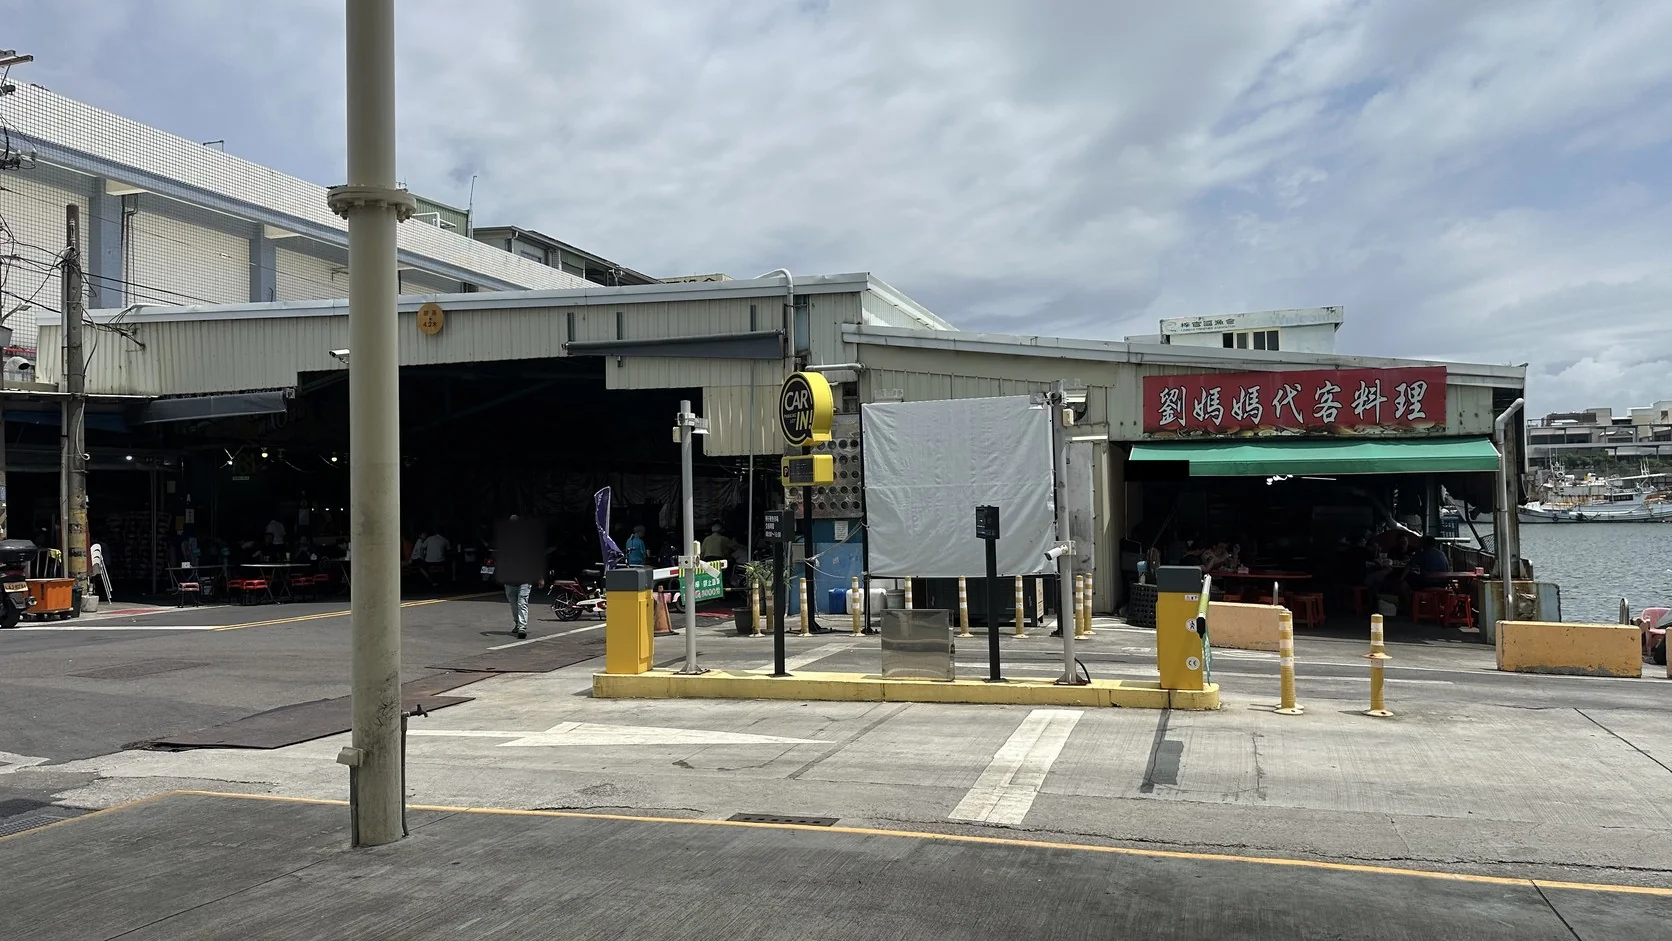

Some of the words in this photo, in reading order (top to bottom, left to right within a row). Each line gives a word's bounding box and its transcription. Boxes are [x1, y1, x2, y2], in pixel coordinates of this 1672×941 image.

[785, 390, 808, 411] CAR
[1158, 379, 1428, 426] 劉媽媽代客料理
[796, 409, 813, 431] IN!
